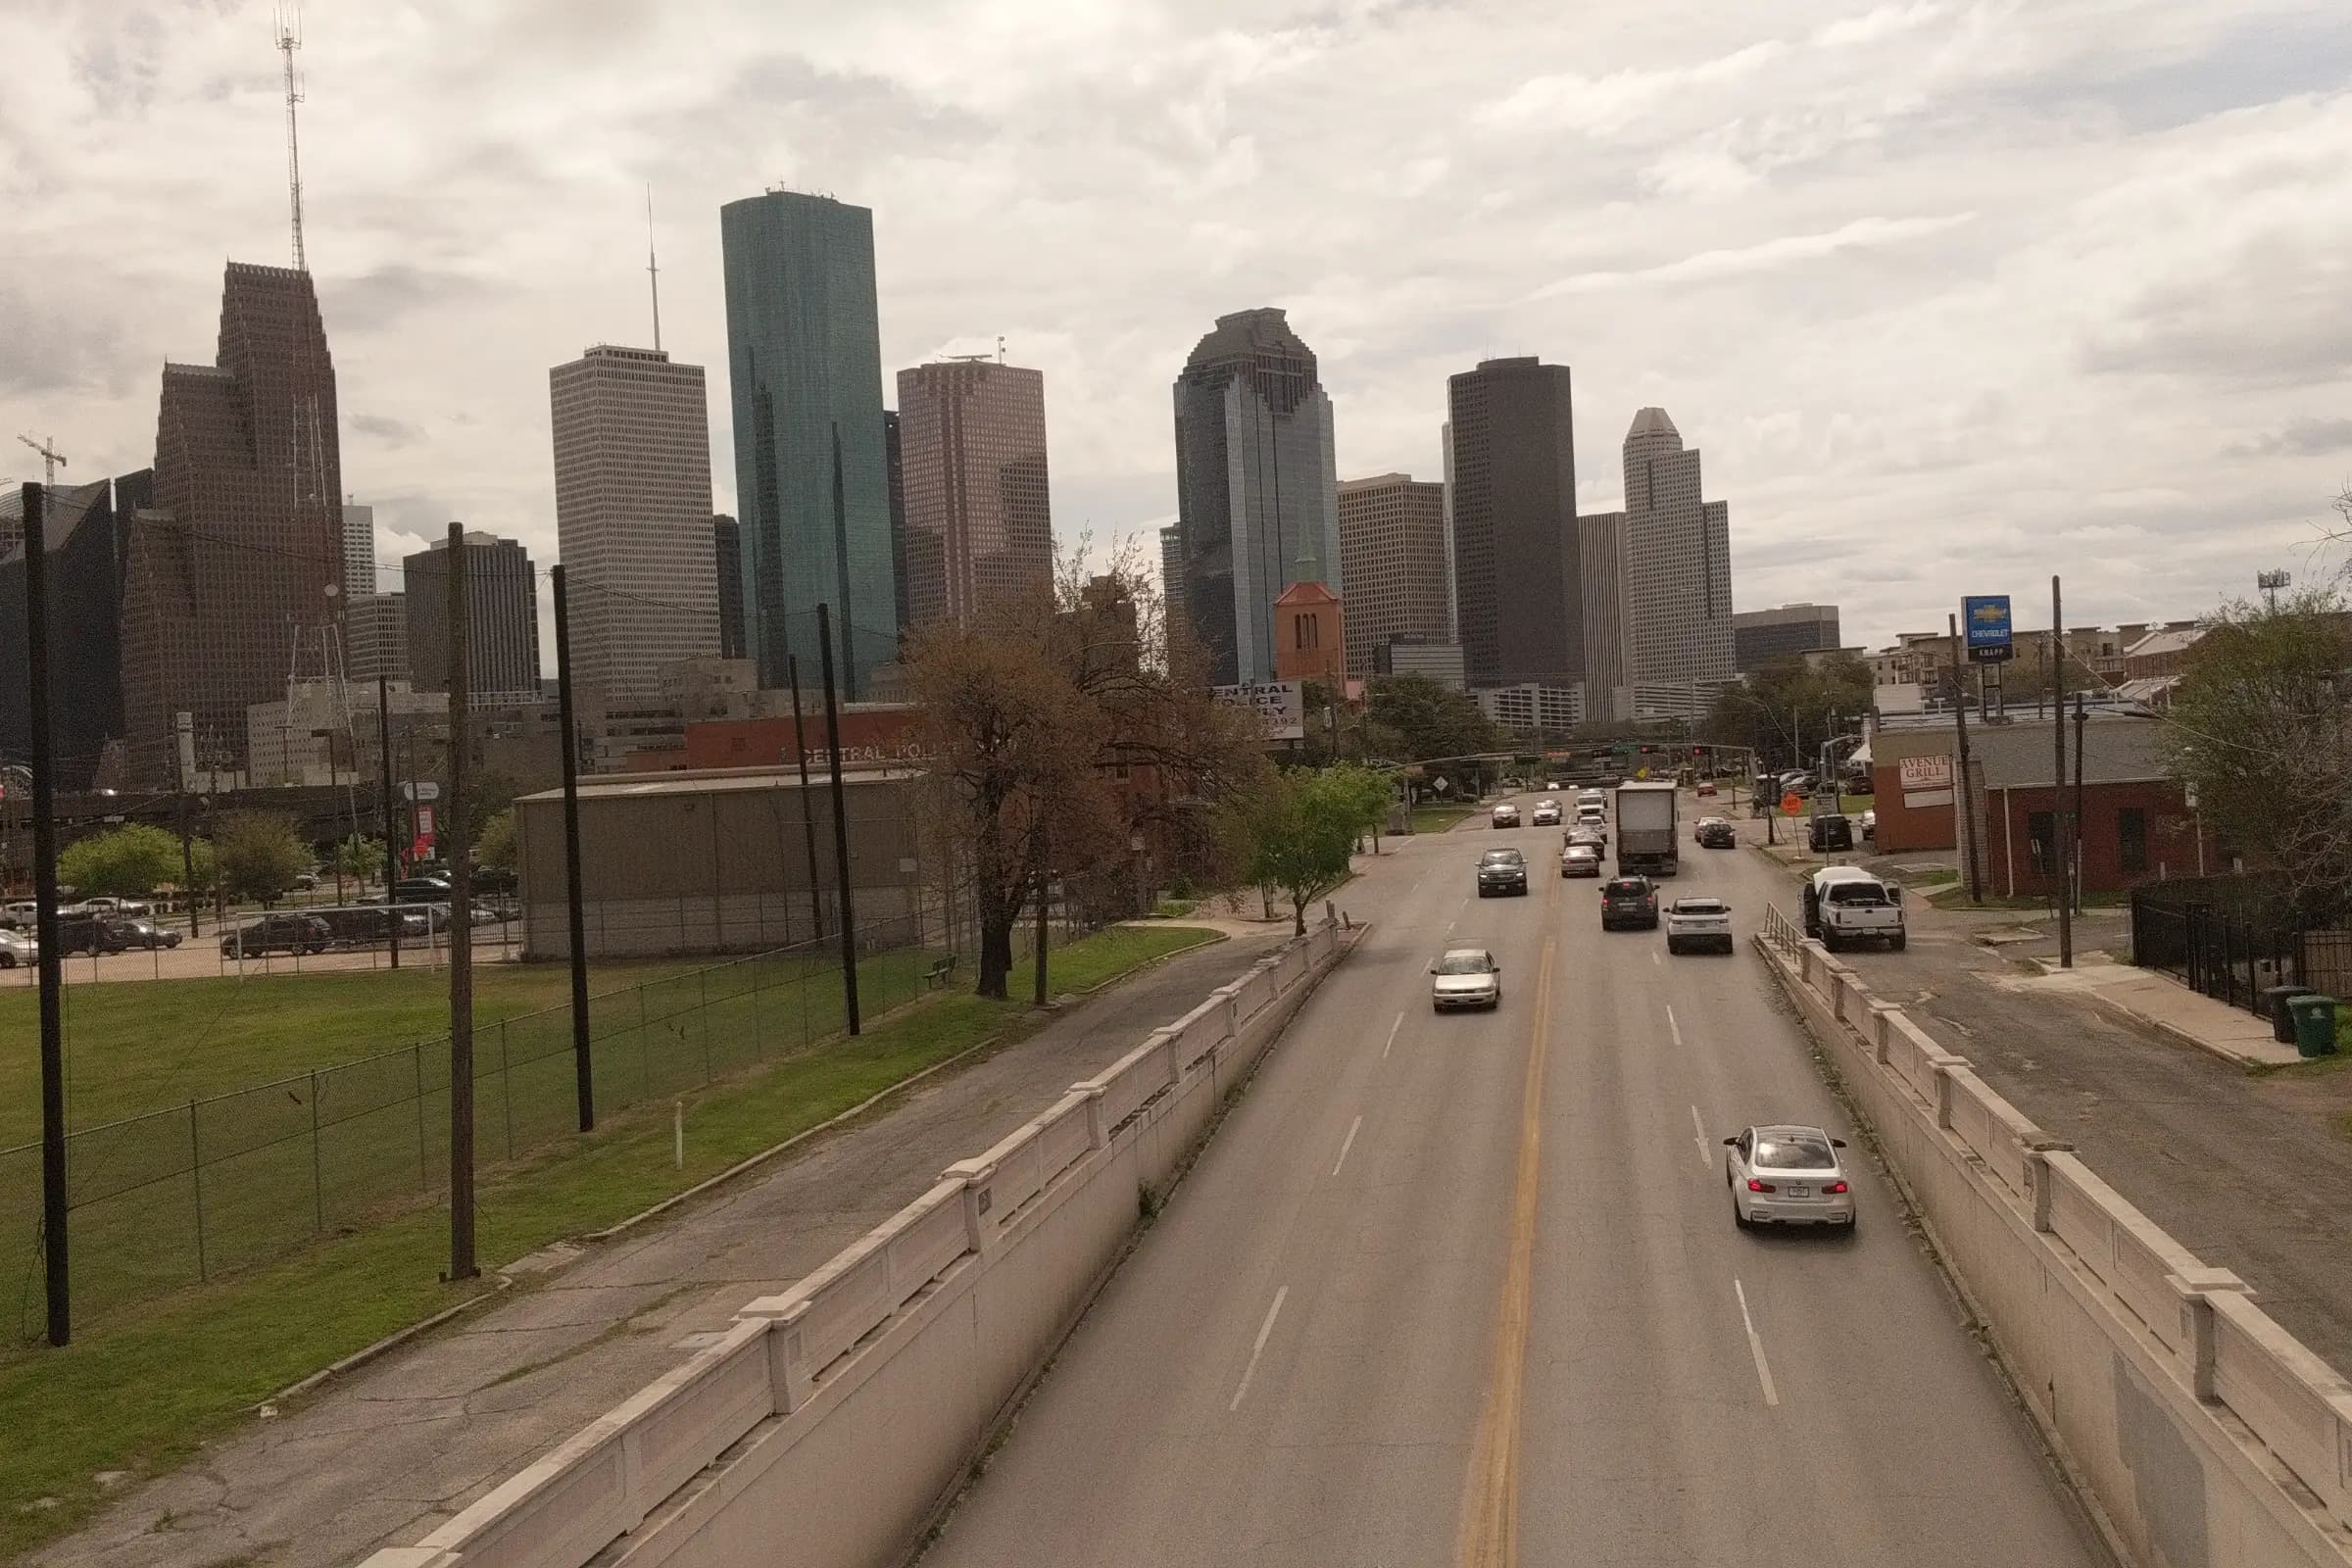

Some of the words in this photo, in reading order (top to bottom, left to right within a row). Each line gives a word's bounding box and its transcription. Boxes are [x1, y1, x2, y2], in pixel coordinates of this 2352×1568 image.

[1972, 629, 2008, 638] CHEVROLET
[1209, 685, 1293, 699] ENTRAL
[1901, 756, 1949, 768] AVENUE
[1906, 766, 1943, 778] GRILL
